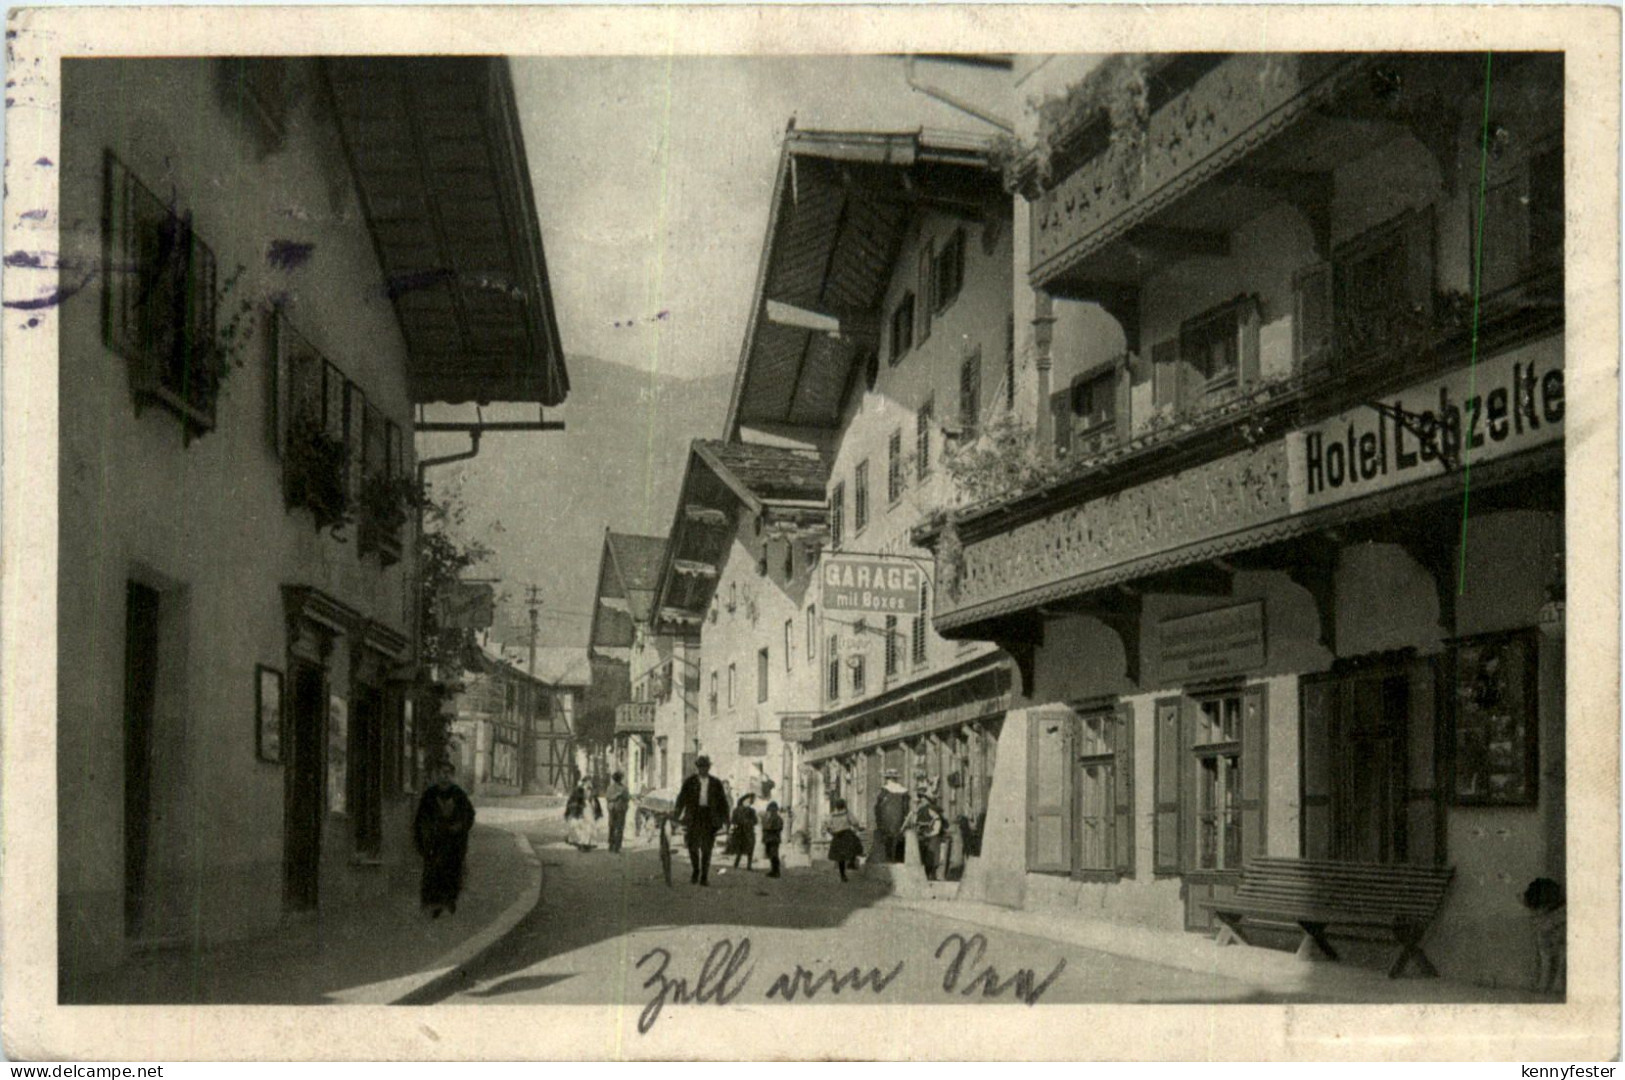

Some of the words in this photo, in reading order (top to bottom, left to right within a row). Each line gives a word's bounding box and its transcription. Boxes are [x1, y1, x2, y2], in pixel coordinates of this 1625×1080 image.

[1305, 404, 1388, 495] Hotel
[825, 563, 917, 591] GARAGE
[862, 591, 905, 610] Boxes
